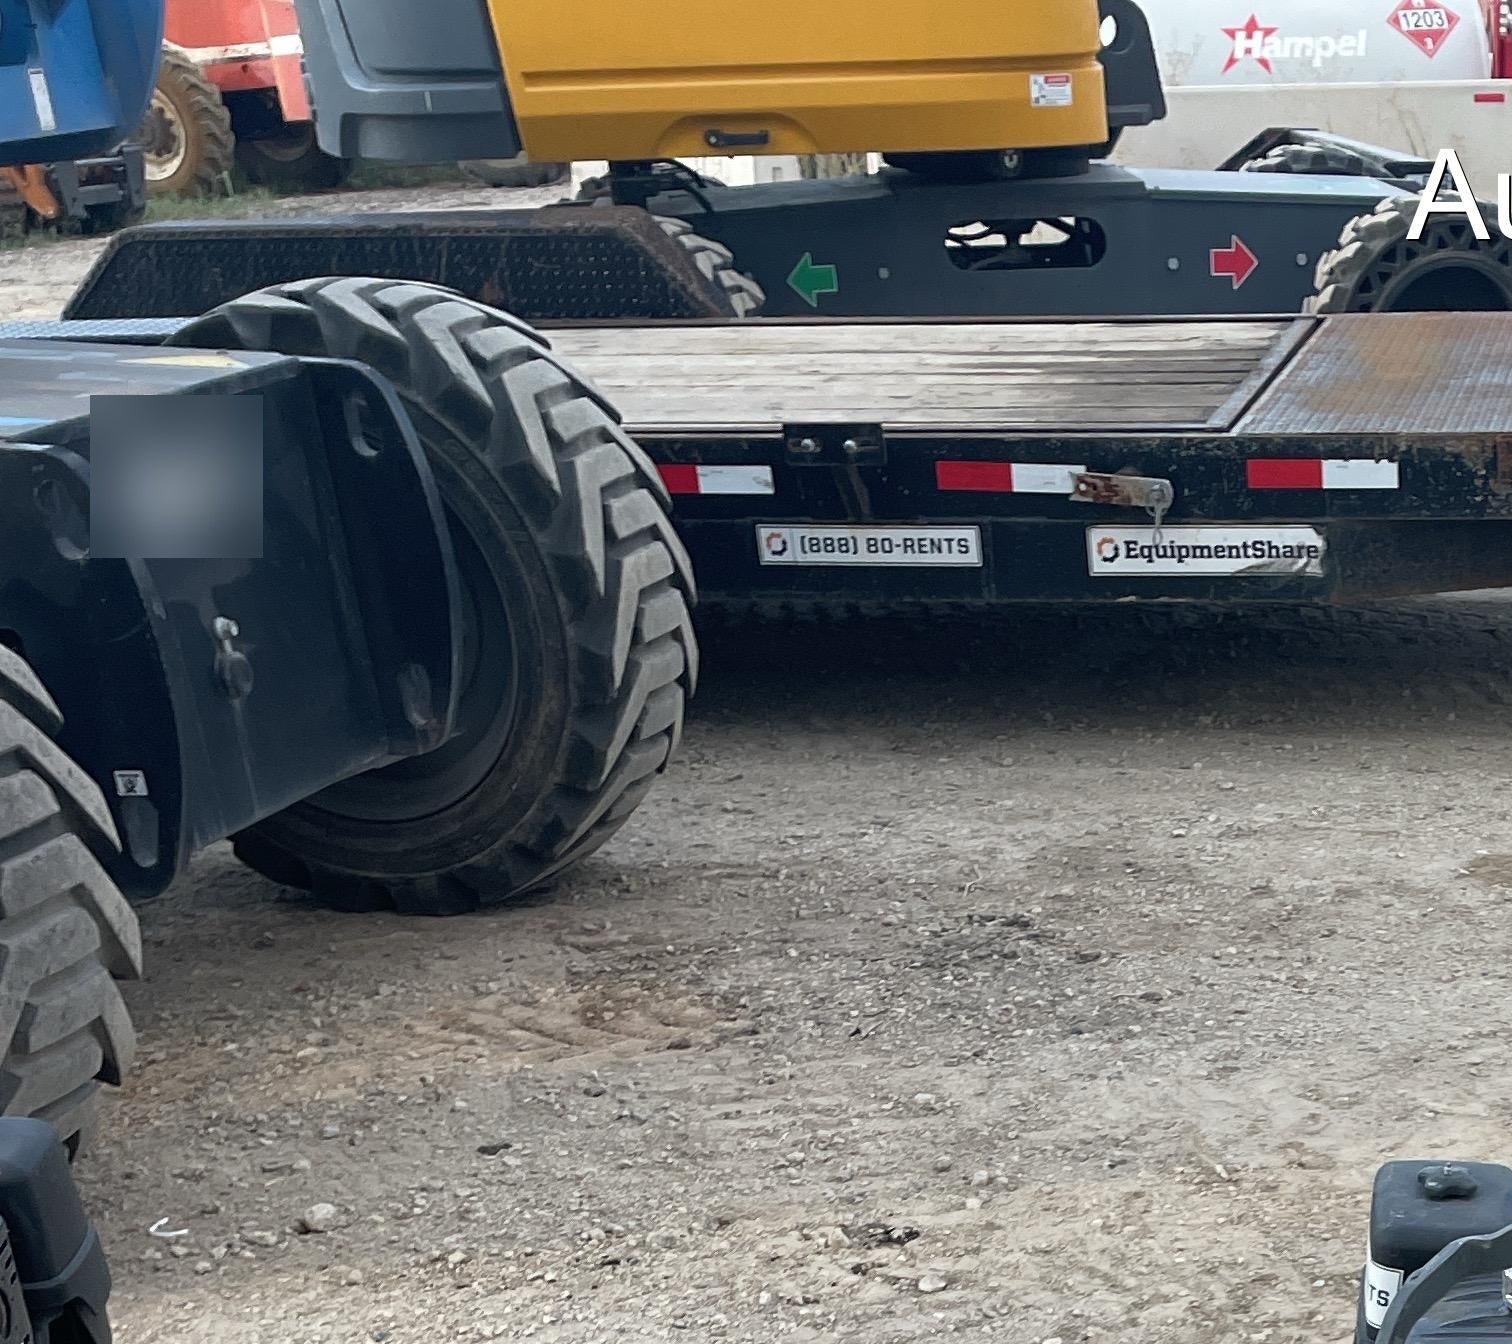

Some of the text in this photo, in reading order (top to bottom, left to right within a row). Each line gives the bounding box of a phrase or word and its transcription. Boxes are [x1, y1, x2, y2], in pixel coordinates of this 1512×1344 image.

[1402, 10, 1445, 28] 1203
[1235, 29, 1368, 68] Hampel
[800, 535, 970, 555] (888) 80-RENTS
[1123, 540, 1319, 564] EquipmentShare
